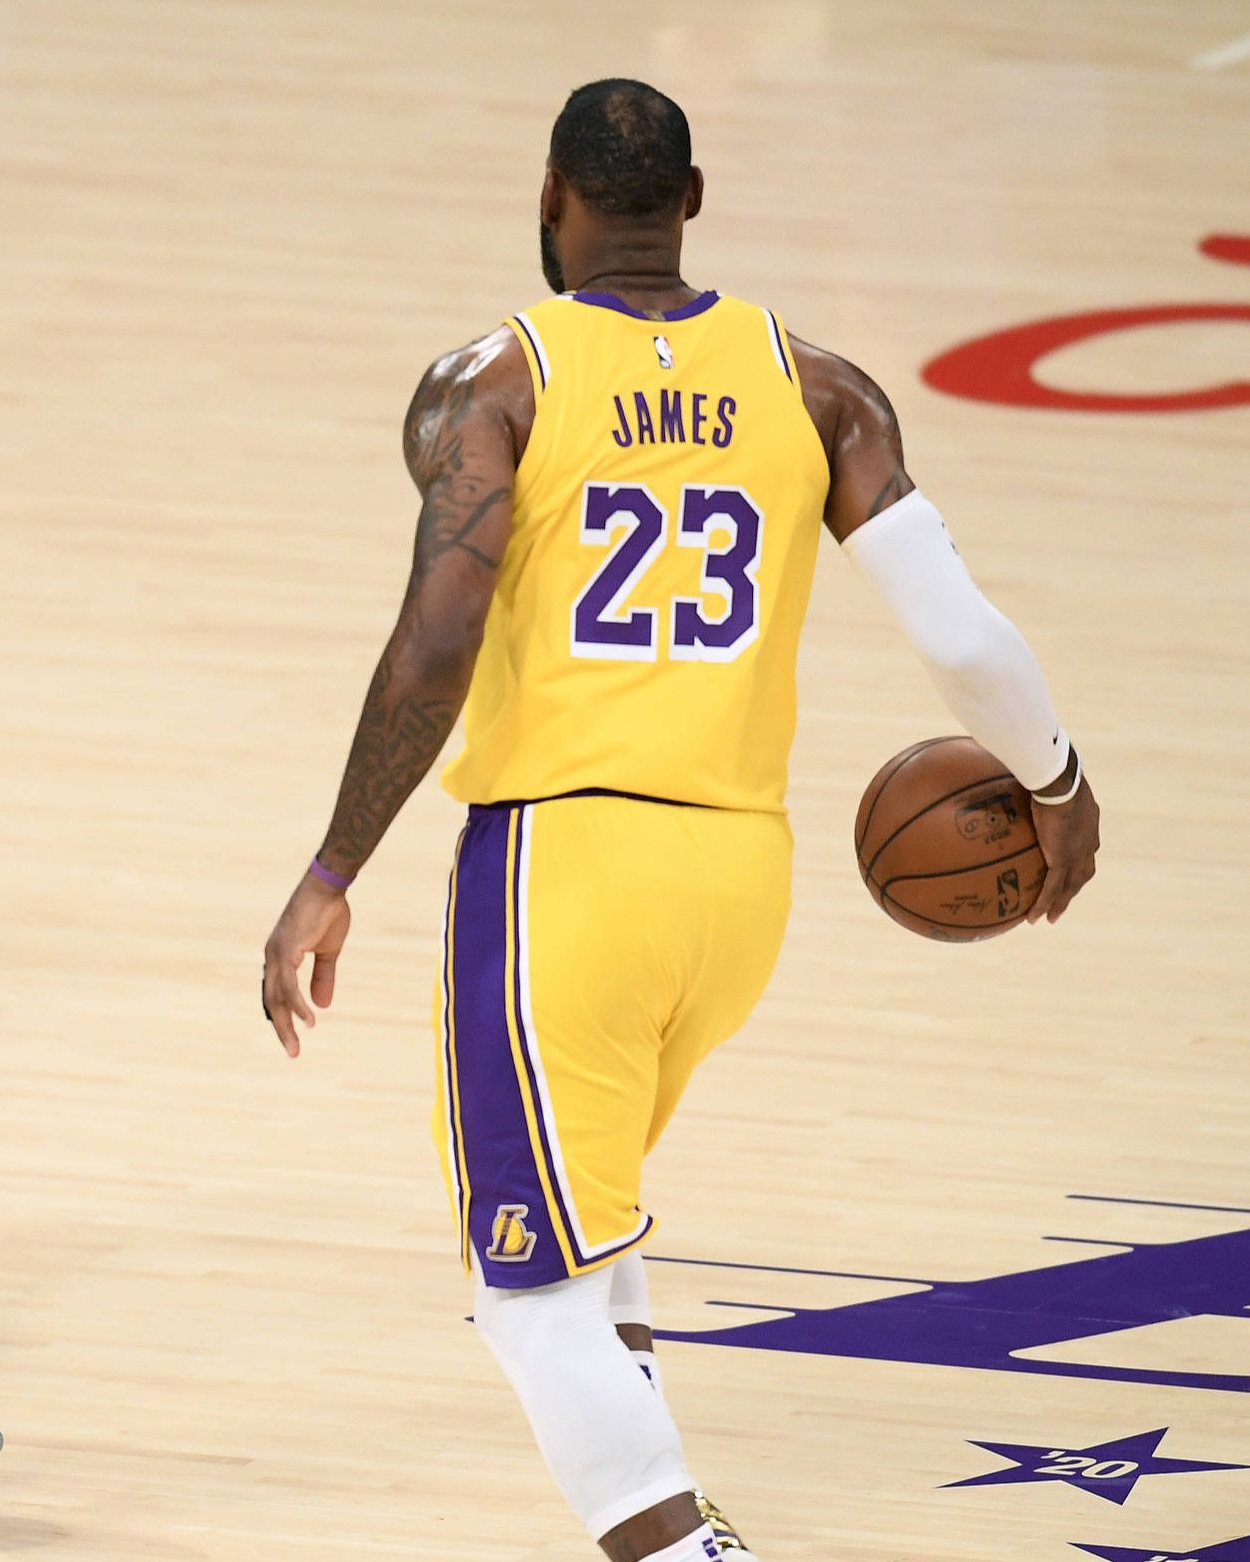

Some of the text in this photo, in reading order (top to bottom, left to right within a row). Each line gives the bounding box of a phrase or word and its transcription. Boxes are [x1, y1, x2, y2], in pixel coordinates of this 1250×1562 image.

[611, 388, 737, 448] JAMES
[569, 479, 765, 664] 23
[1032, 1450, 1140, 1479] '20
